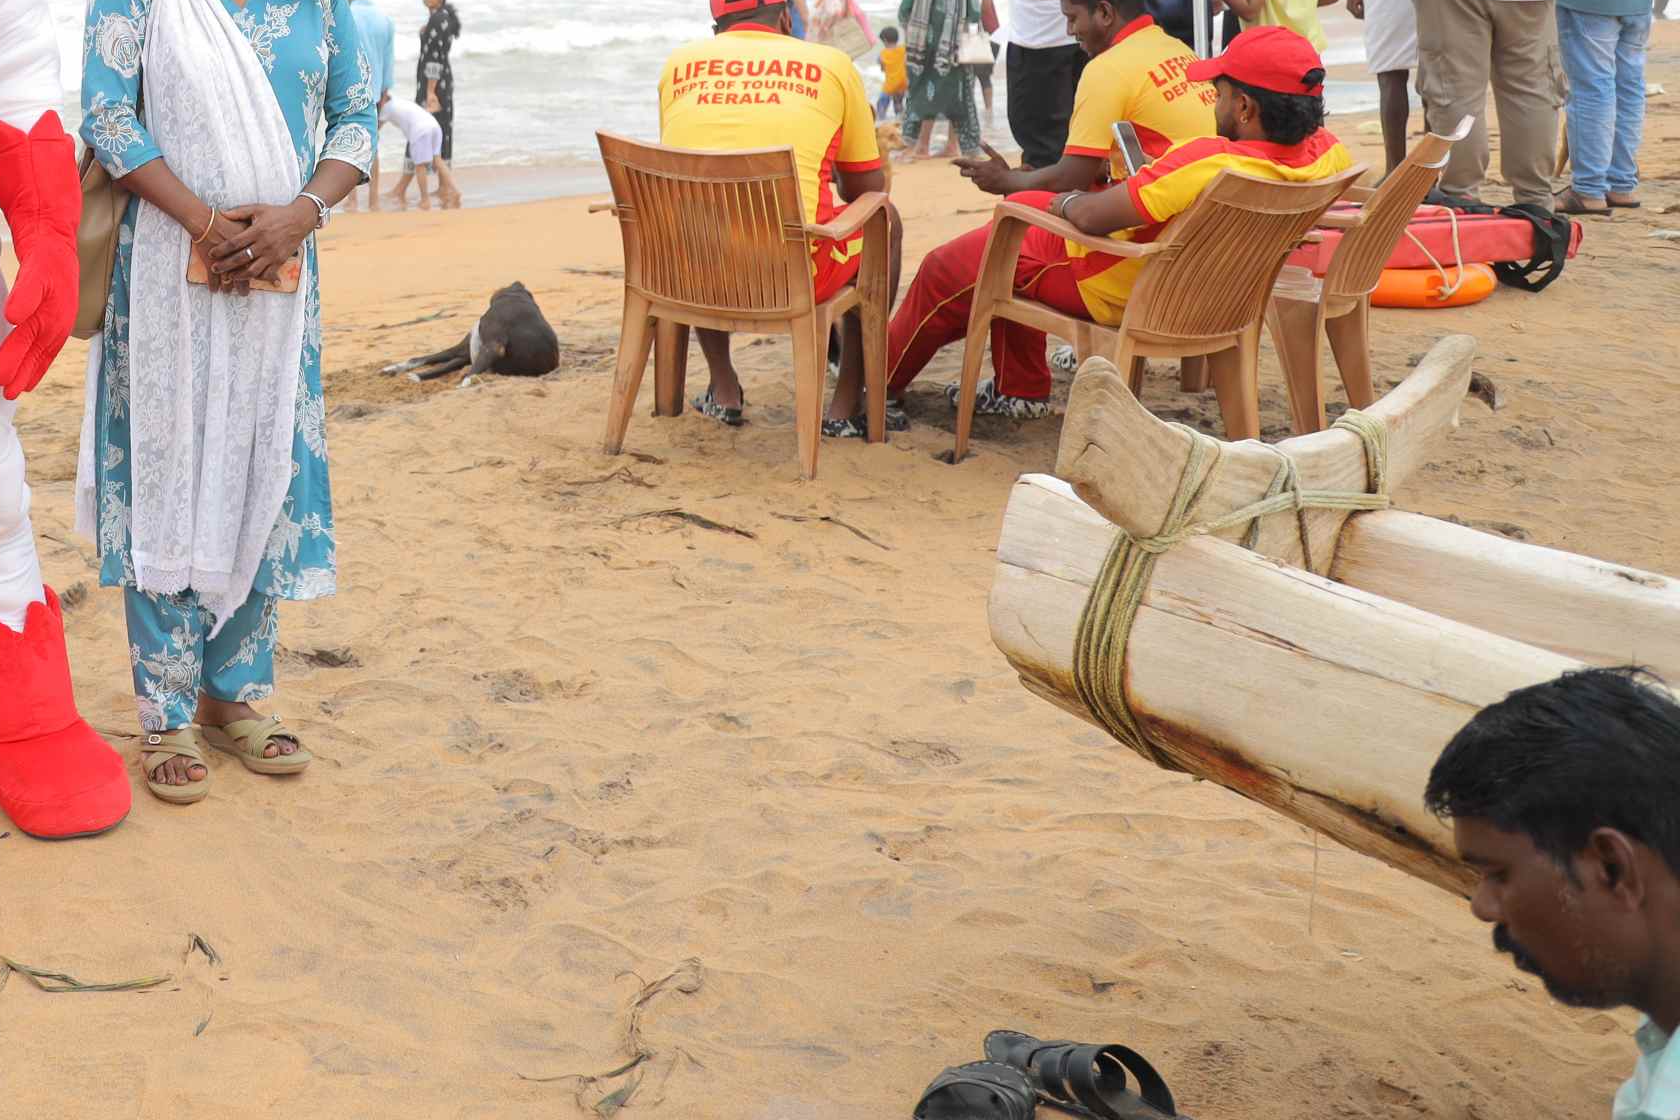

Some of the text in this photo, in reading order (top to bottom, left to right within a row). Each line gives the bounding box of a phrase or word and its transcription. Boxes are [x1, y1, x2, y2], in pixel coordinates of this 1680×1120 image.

[673, 59, 822, 85] LIFEGUARD
[696, 92, 781, 105] KERALA
[714, 80, 736, 90] OF
[741, 80, 819, 100] TOURISM
